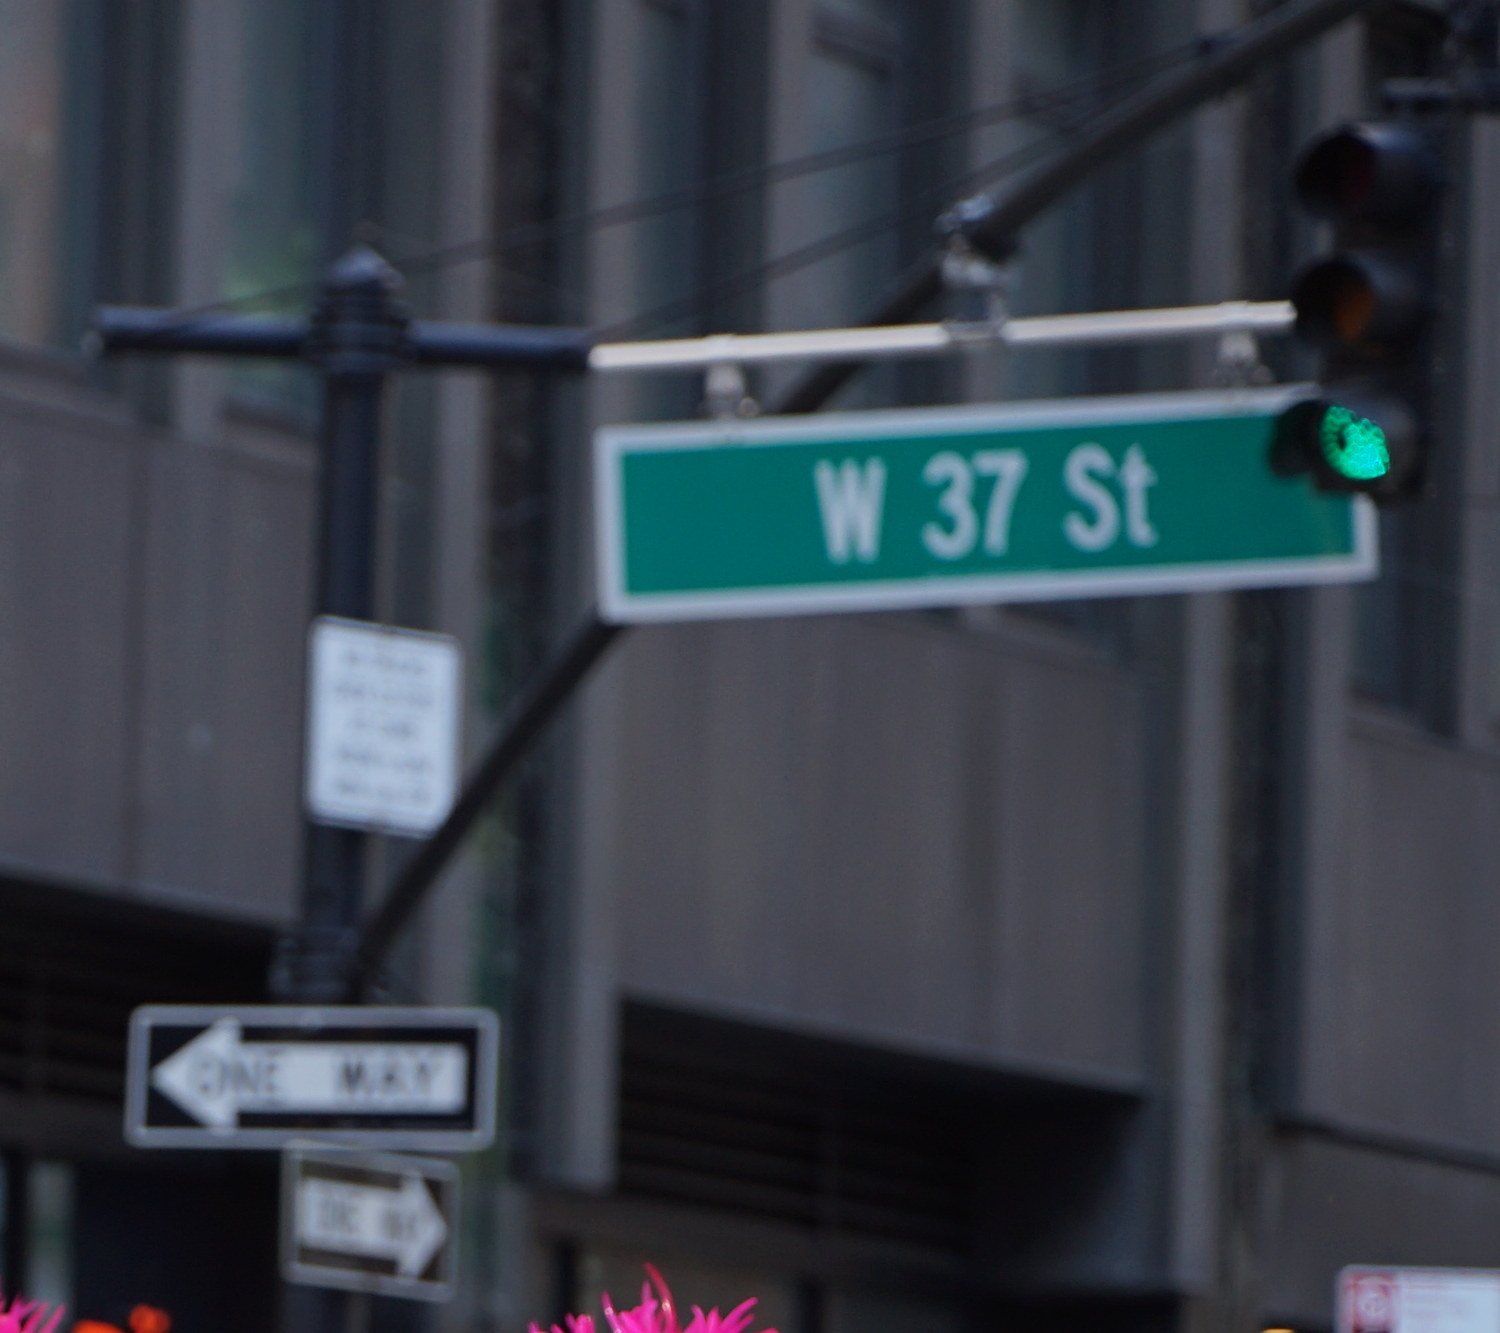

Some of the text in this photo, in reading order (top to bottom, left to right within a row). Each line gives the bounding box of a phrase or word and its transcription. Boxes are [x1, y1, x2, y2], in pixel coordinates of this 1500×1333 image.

[813, 442, 1158, 566] W 37 St
[191, 1056, 438, 1098] ONE WAY
